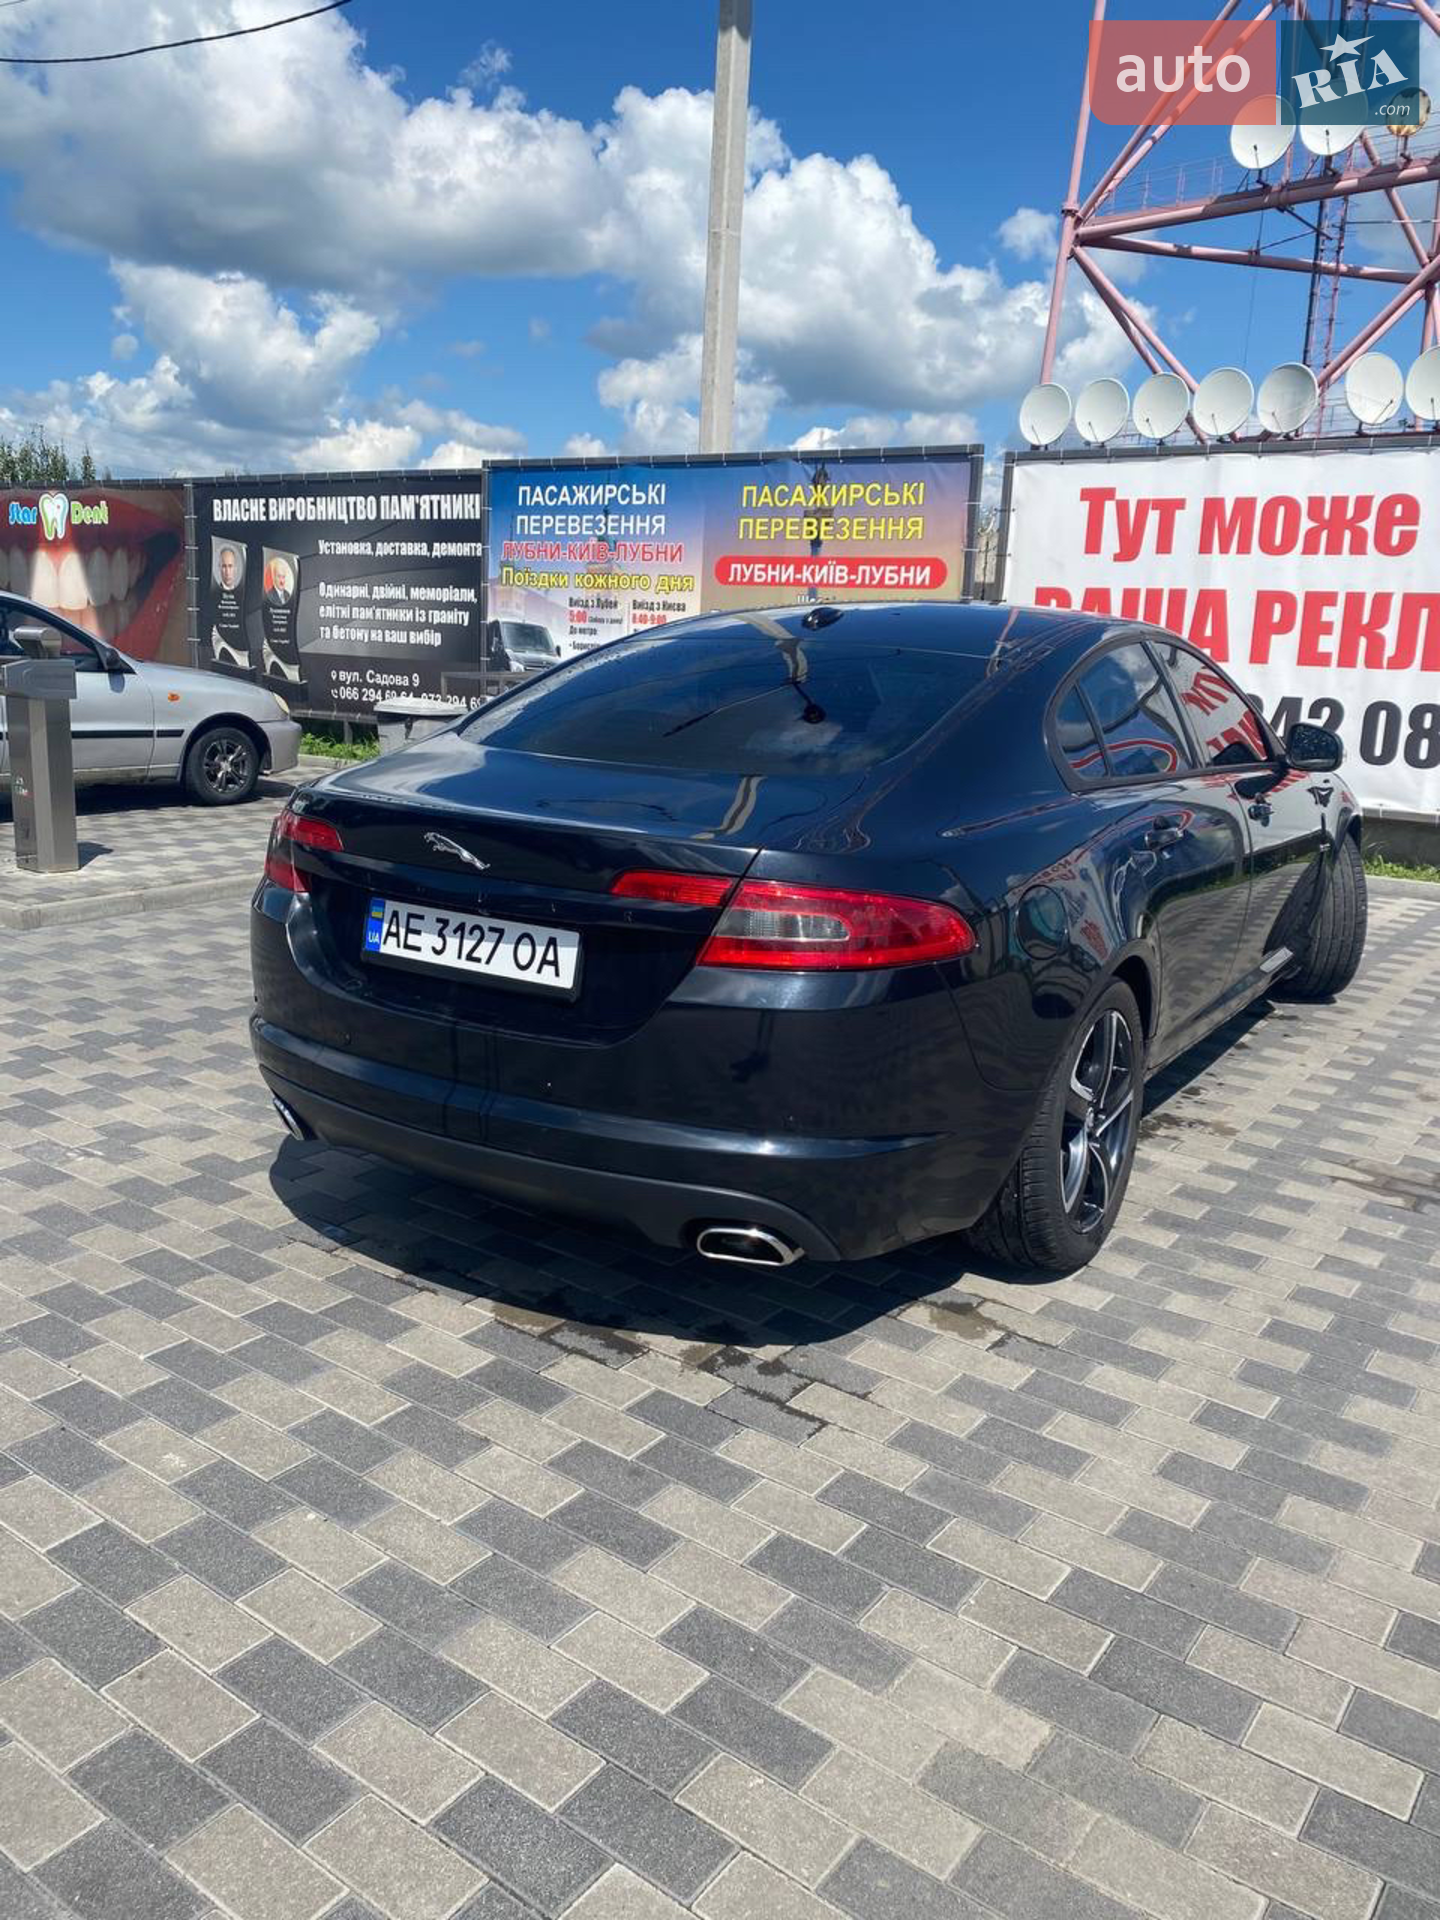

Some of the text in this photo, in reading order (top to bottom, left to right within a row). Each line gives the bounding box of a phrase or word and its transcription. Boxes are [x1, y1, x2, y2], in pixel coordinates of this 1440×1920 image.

[518, 483, 667, 506] ПАСАЖИРСЬКІ
[742, 481, 926, 508] ПАСАЖИРСЬКІ
[8, 500, 109, 526] Star Dent
[212, 498, 267, 522] ВЛАСНЕ
[269, 496, 376, 524] ВИРОБНИЦТВО
[516, 514, 666, 536] ПЕРЕВЕЗЕННЯ
[738, 516, 924, 541] ПЕРЕВЕЗЕННЯ
[1079, 486, 1422, 563] Тут може
[318, 539, 373, 556] Установка,
[375, 540, 430, 558] доставка,
[501, 539, 684, 563] ЛУБНИ-КИЇВ-ЛУБНИ
[500, 565, 695, 595] Поїздки кожного дня
[728, 559, 931, 586] ЛУБНИ-КИЇВ-ЛУБНИ
[411, 585, 478, 605] меморіали,
[415, 608, 427, 623] із
[428, 607, 471, 626] граніту
[320, 624, 442, 647] та бетону на ваш вибір
[339, 669, 420, 687] вул. Садова 9
[339, 686, 360, 701] 066
[362, 687, 382, 702] 294
[368, 931, 381, 944] UA
[383, 909, 560, 978] AE 3127 OA
